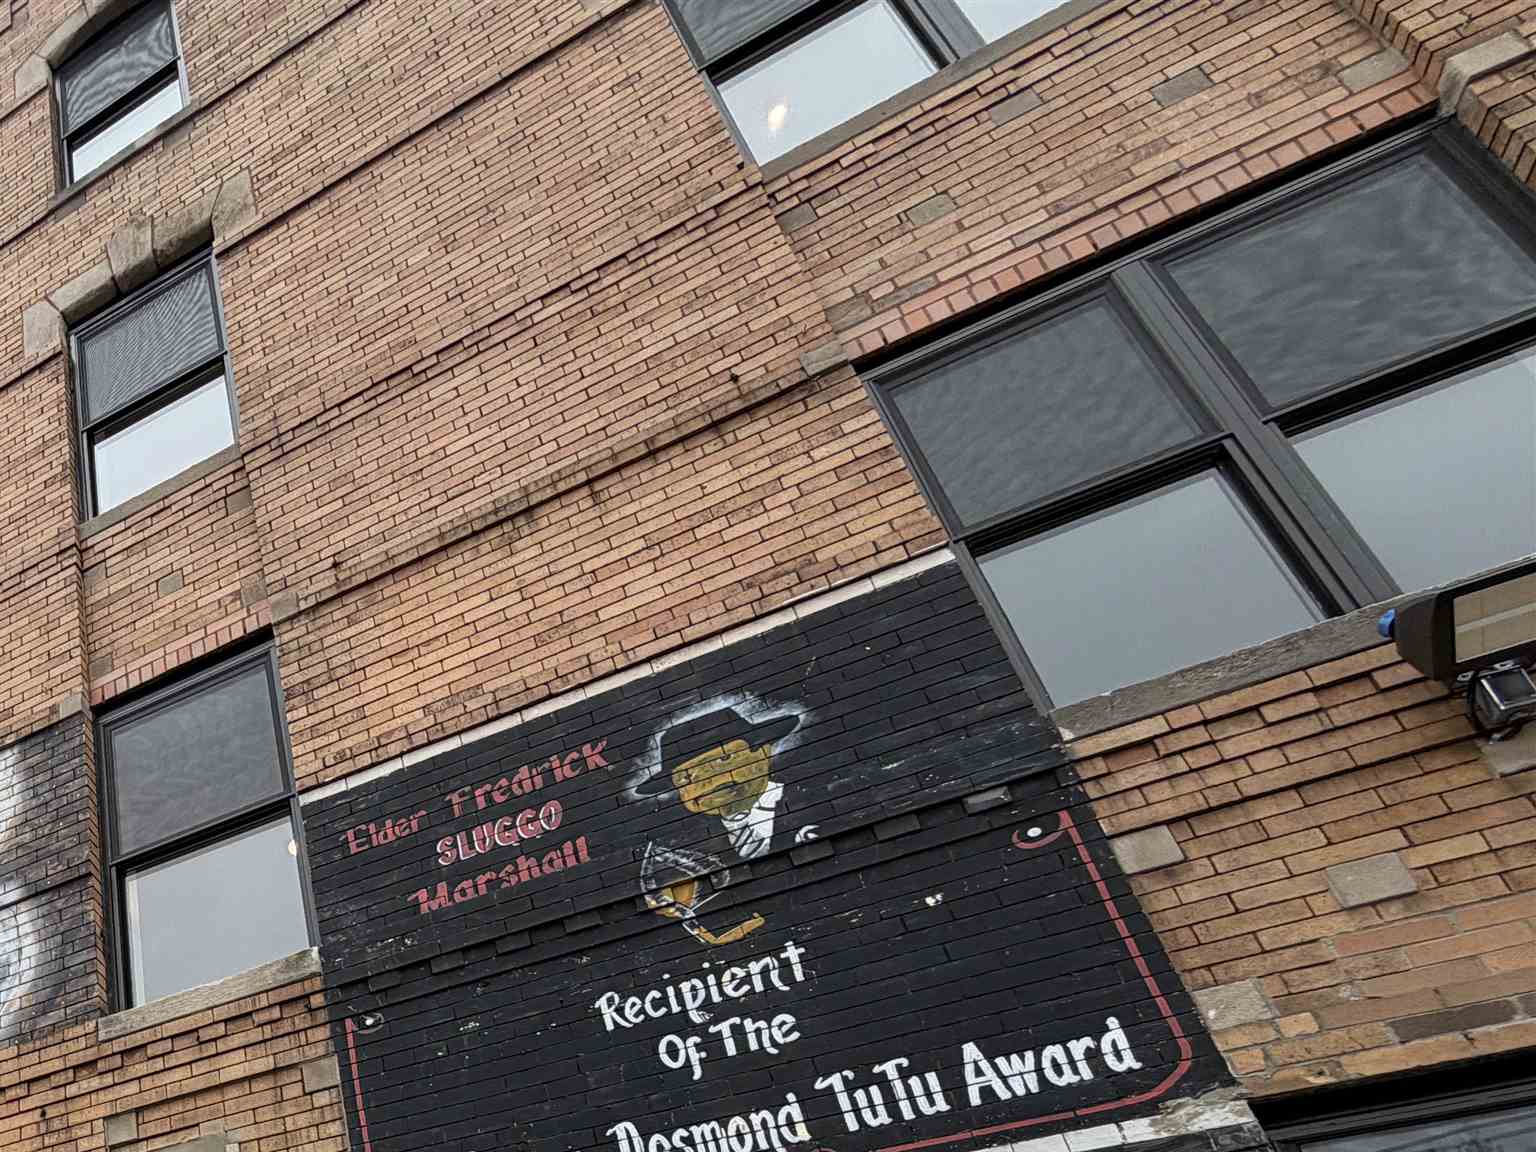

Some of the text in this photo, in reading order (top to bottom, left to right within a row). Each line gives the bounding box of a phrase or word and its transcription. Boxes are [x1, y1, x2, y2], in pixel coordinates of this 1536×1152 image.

[345, 738, 610, 855] Elder Fredrick
[435, 801, 564, 865] SLUGGO
[407, 836, 589, 914] Marshall
[594, 942, 805, 1030] Recipient
[658, 1009, 801, 1079] Of The
[814, 1057, 949, 1133] TuTu
[961, 1017, 1142, 1108] Award
